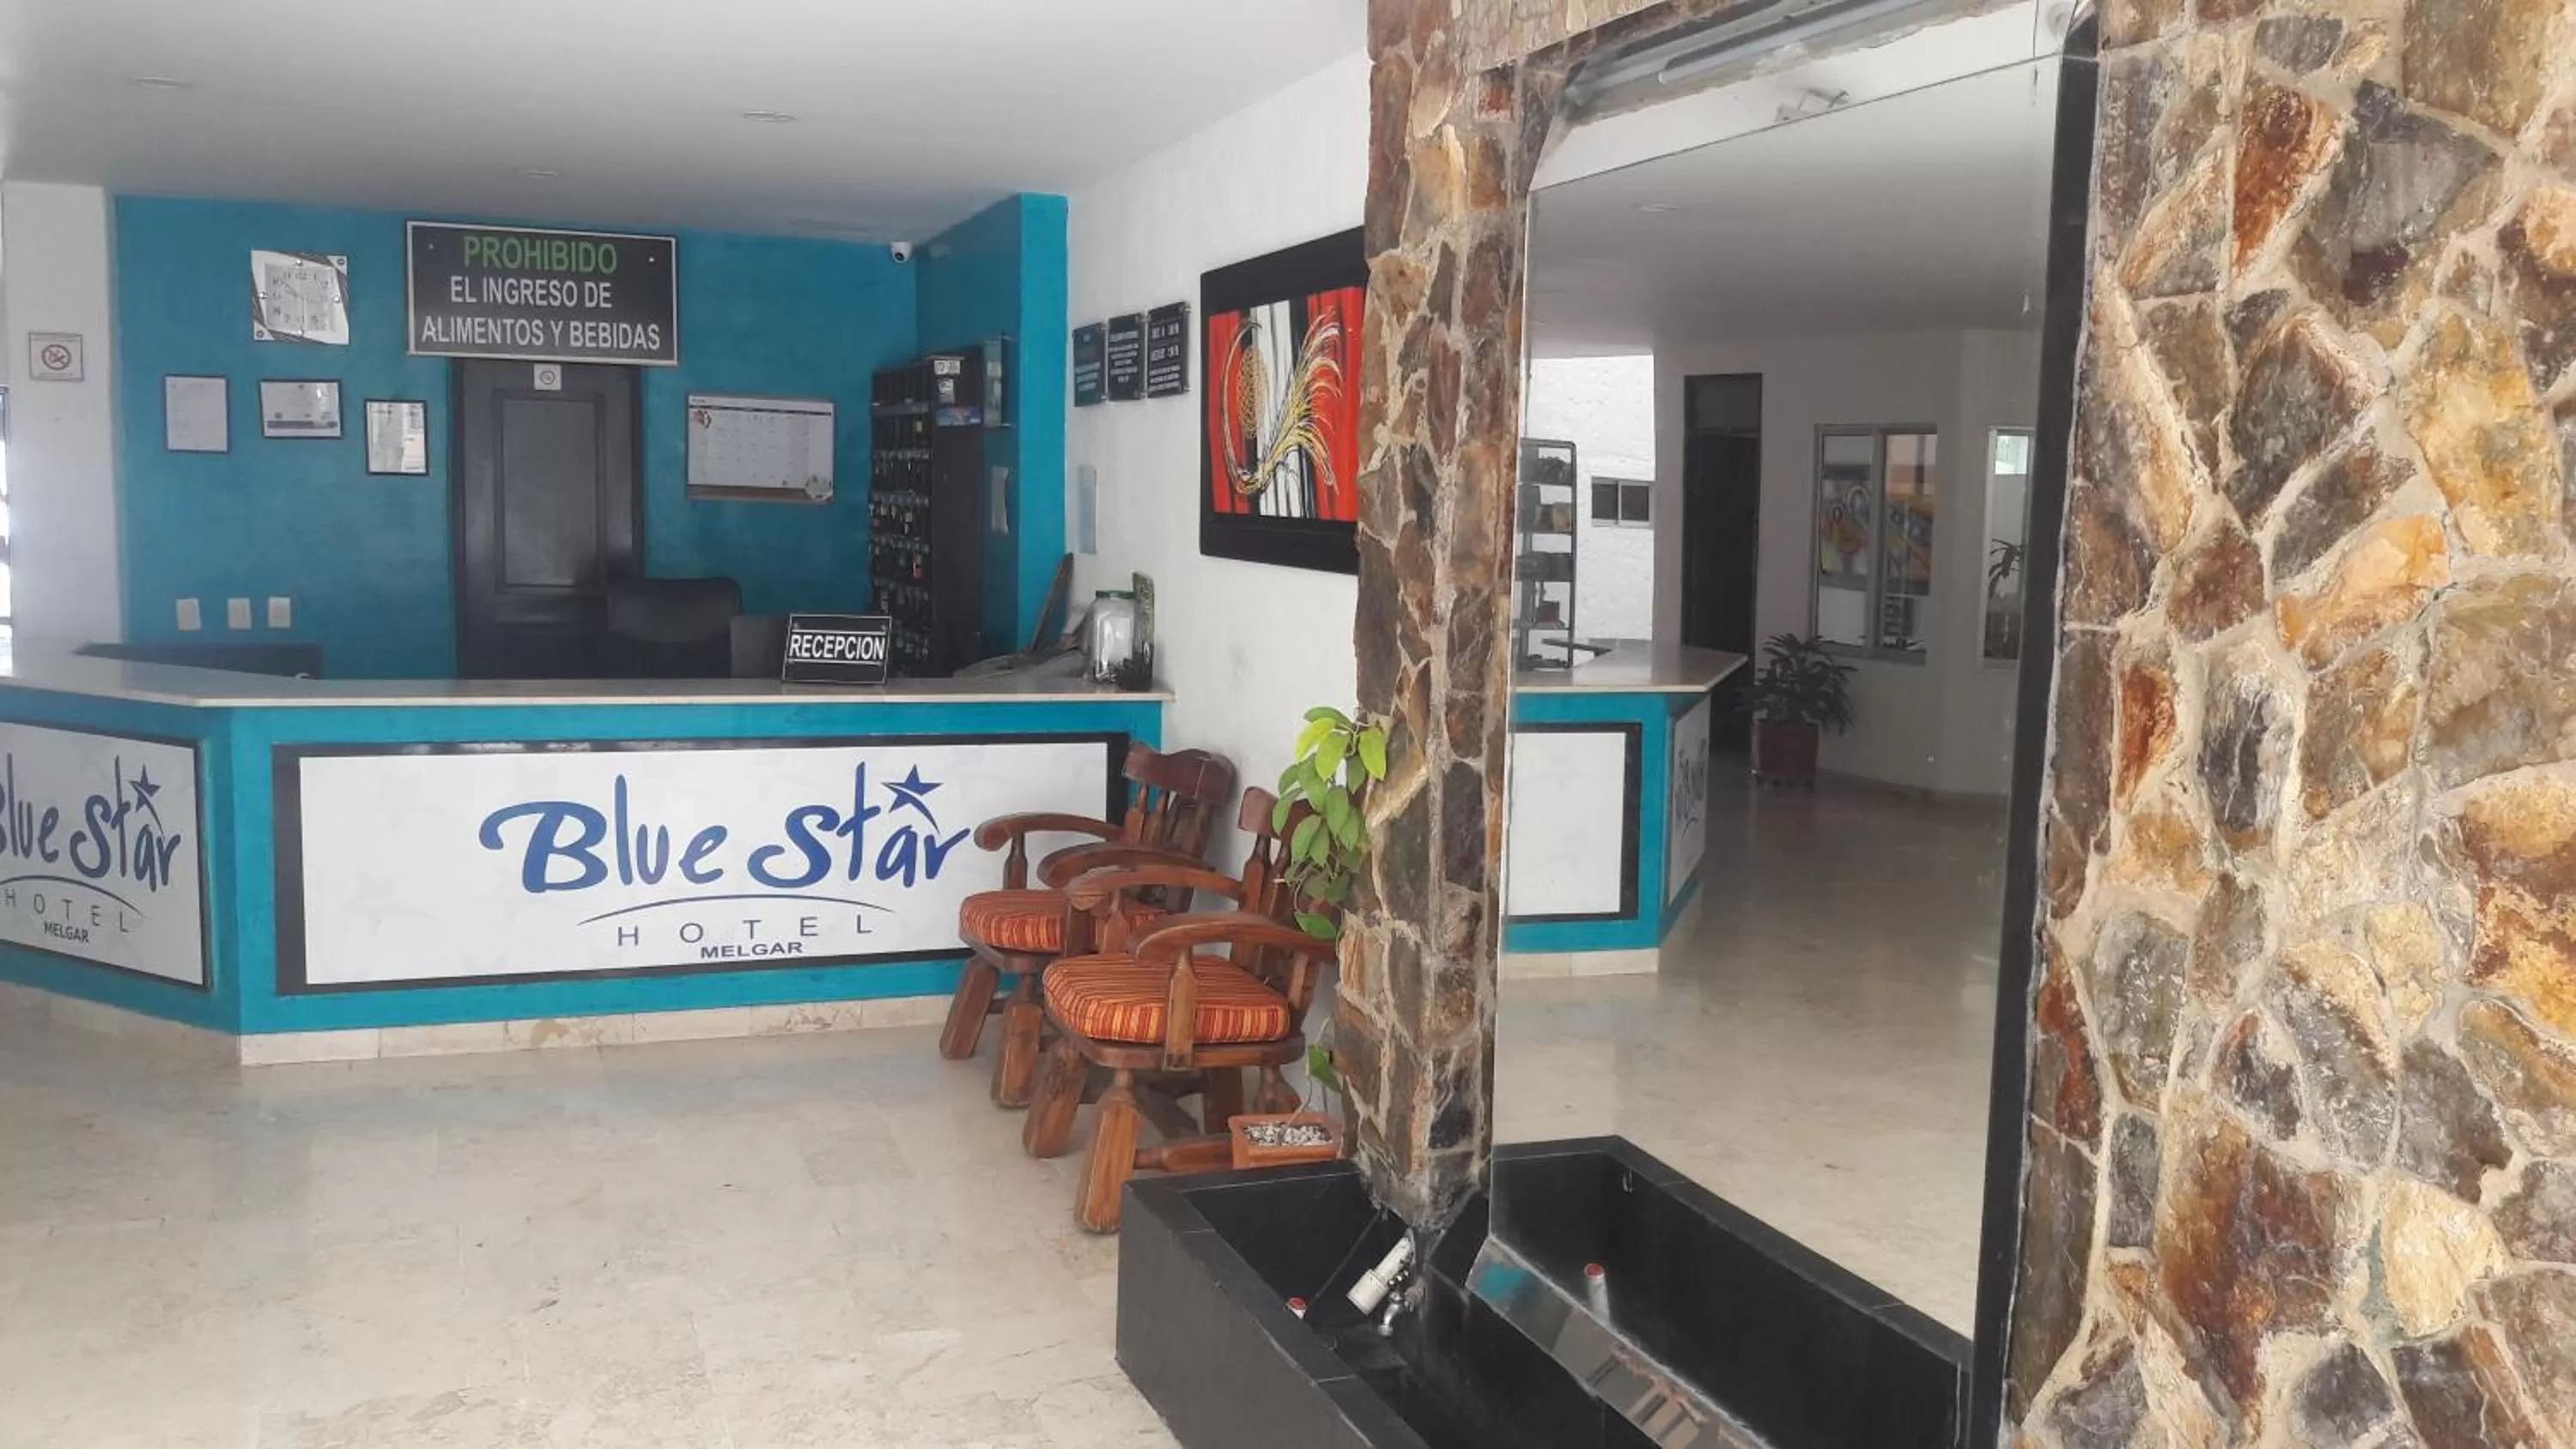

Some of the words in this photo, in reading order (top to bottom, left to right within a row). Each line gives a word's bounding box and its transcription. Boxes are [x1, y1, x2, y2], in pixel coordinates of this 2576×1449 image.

[463, 235, 617, 274] PROHIBIDO
[450, 276, 477, 303] EL
[483, 277, 578, 308] INGRESO
[585, 281, 612, 308] DE
[422, 316, 544, 346] ALIMENTOS
[550, 320, 564, 344] Y
[569, 321, 660, 350] BEBIDAS
[789, 634, 885, 660] RECEPCION
[70, 755, 181, 893] Star
[479, 774, 728, 893] Blue
[747, 761, 971, 888] Star
[44, 920, 89, 943] MELGAR
[617, 914, 873, 946] HOTEL
[700, 941, 804, 960] MELGAR
